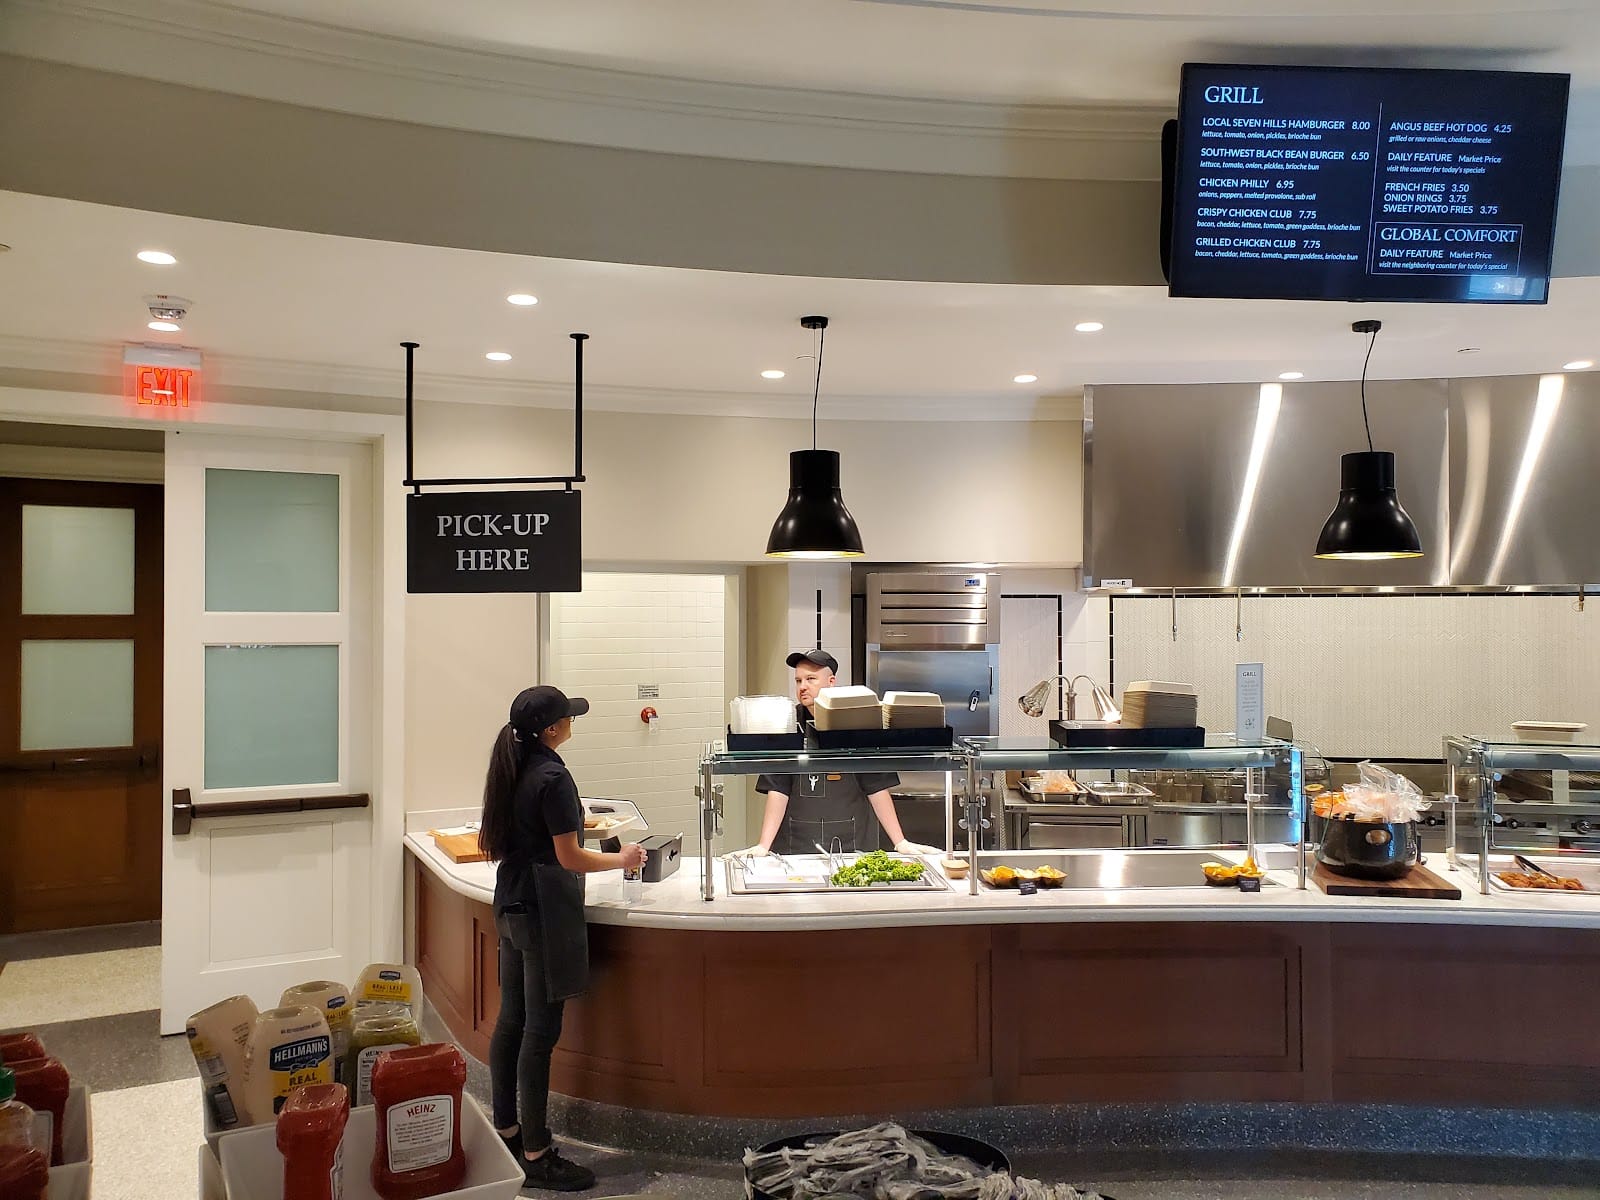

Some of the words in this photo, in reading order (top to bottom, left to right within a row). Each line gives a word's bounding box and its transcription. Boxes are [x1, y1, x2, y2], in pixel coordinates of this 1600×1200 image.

[1204, 86, 1264, 104] GRILL
[1203, 117, 1231, 126] LOCAL
[1233, 118, 1261, 127] SEVEN
[1262, 119, 1286, 128] HILLS
[1288, 120, 1345, 129] HAMBURGER
[1352, 121, 1370, 130] 8.00
[1390, 122, 1421, 131] ANGUS
[1424, 123, 1444, 131] BEEF
[1467, 124, 1487, 132] DOG
[1494, 125, 1512, 133] 4.25
[1202, 130, 1223, 138] lettuce,
[1224, 131, 1246, 139] tomato,
[1265, 132, 1287, 140] pickles,
[1389, 135, 1407, 143] grilled
[1201, 148, 1255, 158] SOUTHWEST
[1256, 149, 1283, 158] BLACK
[1285, 150, 1308, 159] BEAN
[1310, 151, 1344, 160] BURGER
[1351, 152, 1369, 160] 6.50
[1387, 152, 1413, 161] DAILY
[1414, 153, 1452, 162] FEATURE
[1459, 155, 1483, 163] Market
[1222, 161, 1244, 169] tomato,
[1432, 166, 1441, 174] for
[1442, 166, 1462, 174] today's
[1199, 178, 1238, 187] CHICKEN
[1240, 179, 1269, 188] PHILLY
[1276, 180, 1294, 189] 6.95
[1385, 183, 1421, 191] FRENCH
[1422, 183, 1445, 192] FRIES
[1451, 184, 1469, 193] 3.50
[1384, 193, 1415, 202] ONION
[1416, 194, 1443, 202] RINGS
[1449, 195, 1467, 203] 3.75
[1198, 208, 1228, 217] CRISPY
[1229, 208, 1267, 218] CHICKEN
[1269, 209, 1292, 218] CLUB
[1299, 210, 1316, 219] 7.75
[1383, 204, 1413, 213] SWEET
[1414, 205, 1449, 213] POTATO
[1450, 205, 1473, 214] FRIES
[1480, 206, 1498, 215] 3.75
[1197, 220, 1215, 228] bacon,
[1241, 221, 1262, 229] lettuce,
[1381, 228, 1441, 241] GLOBAL
[1444, 229, 1518, 242] COMFORT
[1195, 237, 1231, 247] GRILLED
[1233, 239, 1271, 248] CHICKEN
[1273, 239, 1296, 248] CLUB
[1303, 240, 1320, 248] 7.75
[1380, 249, 1405, 257] DAILY
[1406, 250, 1443, 258] FEATURE
[1450, 251, 1473, 259] Market
[1458, 263, 1466, 271] for
[137, 367, 192, 407] EXIT
[437, 513, 550, 537] PICK-UP
[456, 549, 530, 571] HERE
[274, 1038, 328, 1063] HELLMANN'S
[289, 1072, 317, 1086] REAL
[407, 1104, 436, 1117] HEINZ
